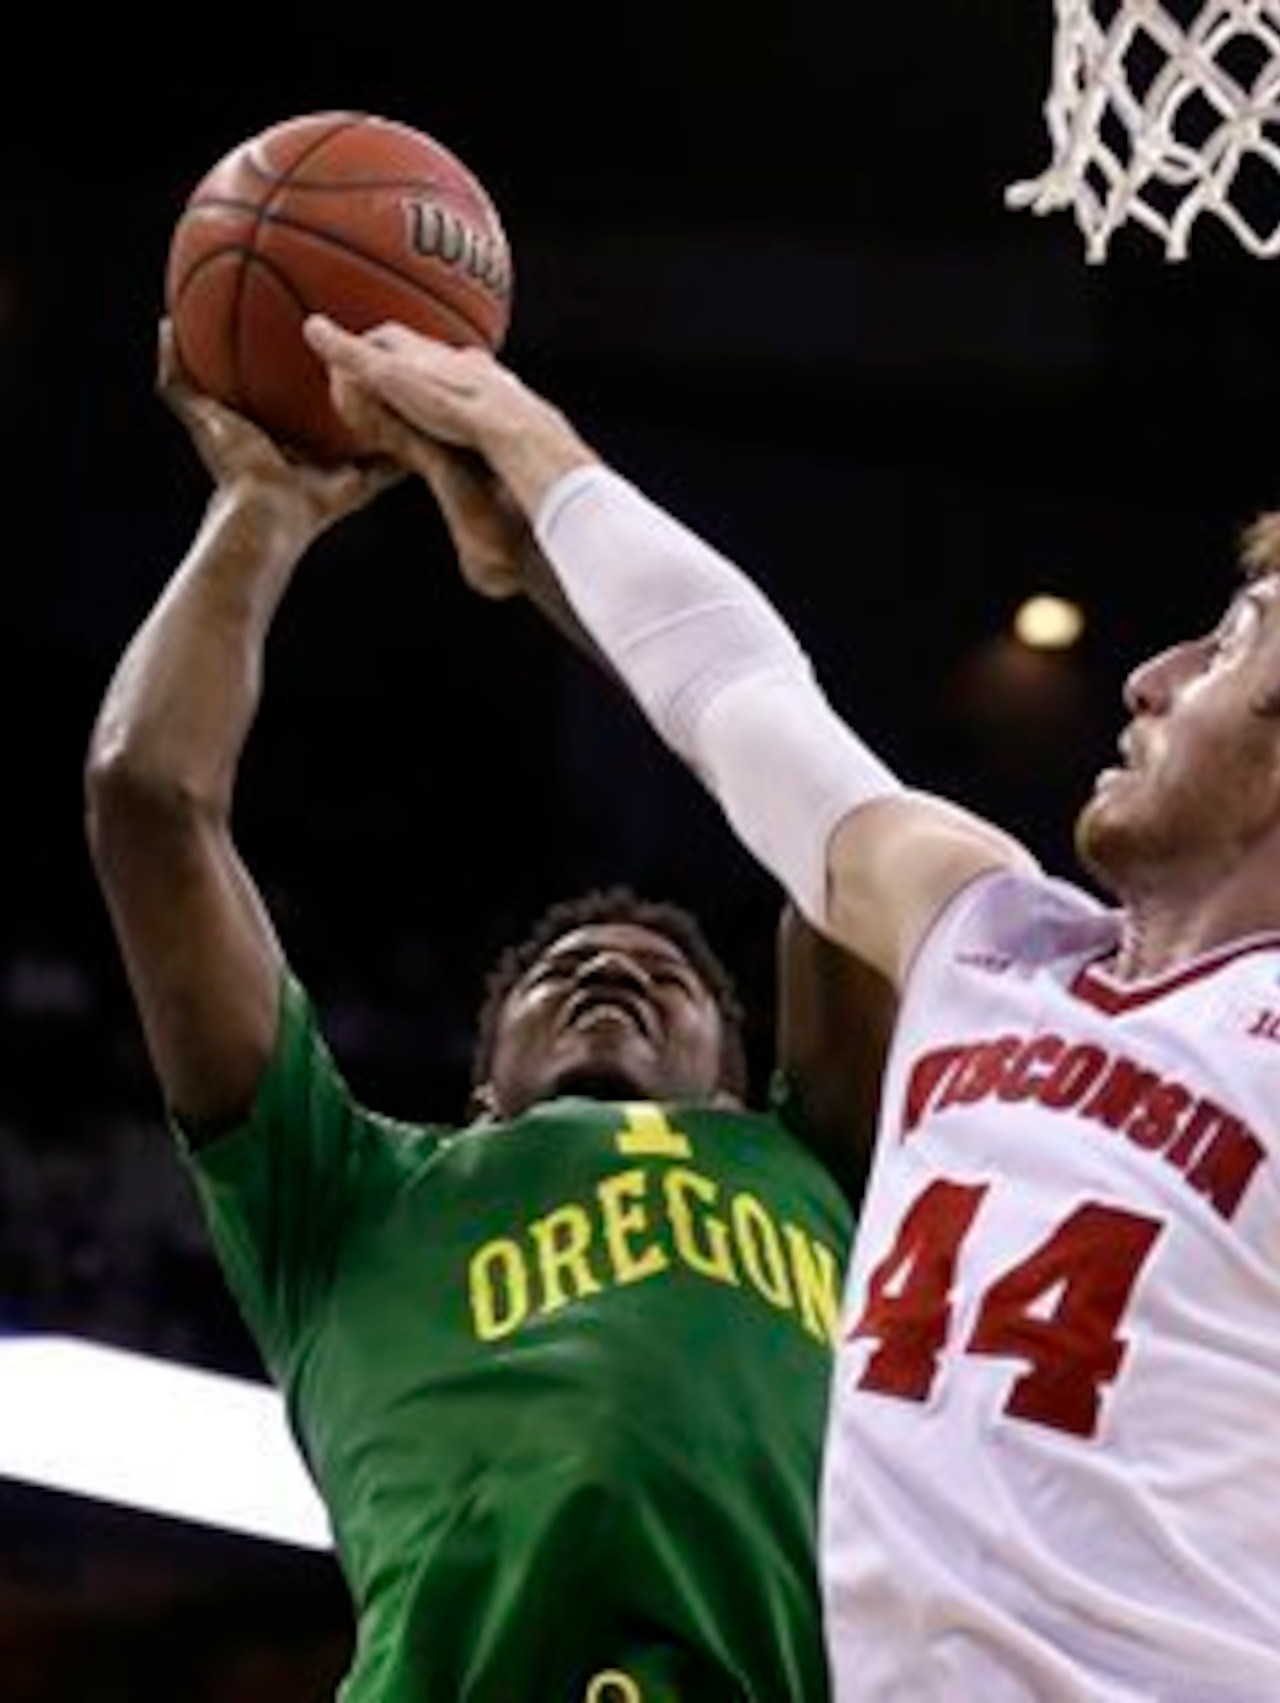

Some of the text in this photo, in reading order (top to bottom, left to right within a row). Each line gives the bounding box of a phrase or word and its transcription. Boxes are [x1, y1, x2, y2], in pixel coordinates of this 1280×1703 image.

[900, 1034, 1269, 1223] WISCONSIN
[469, 1168, 840, 1343] OREGON
[847, 1177, 1168, 1441] 44
